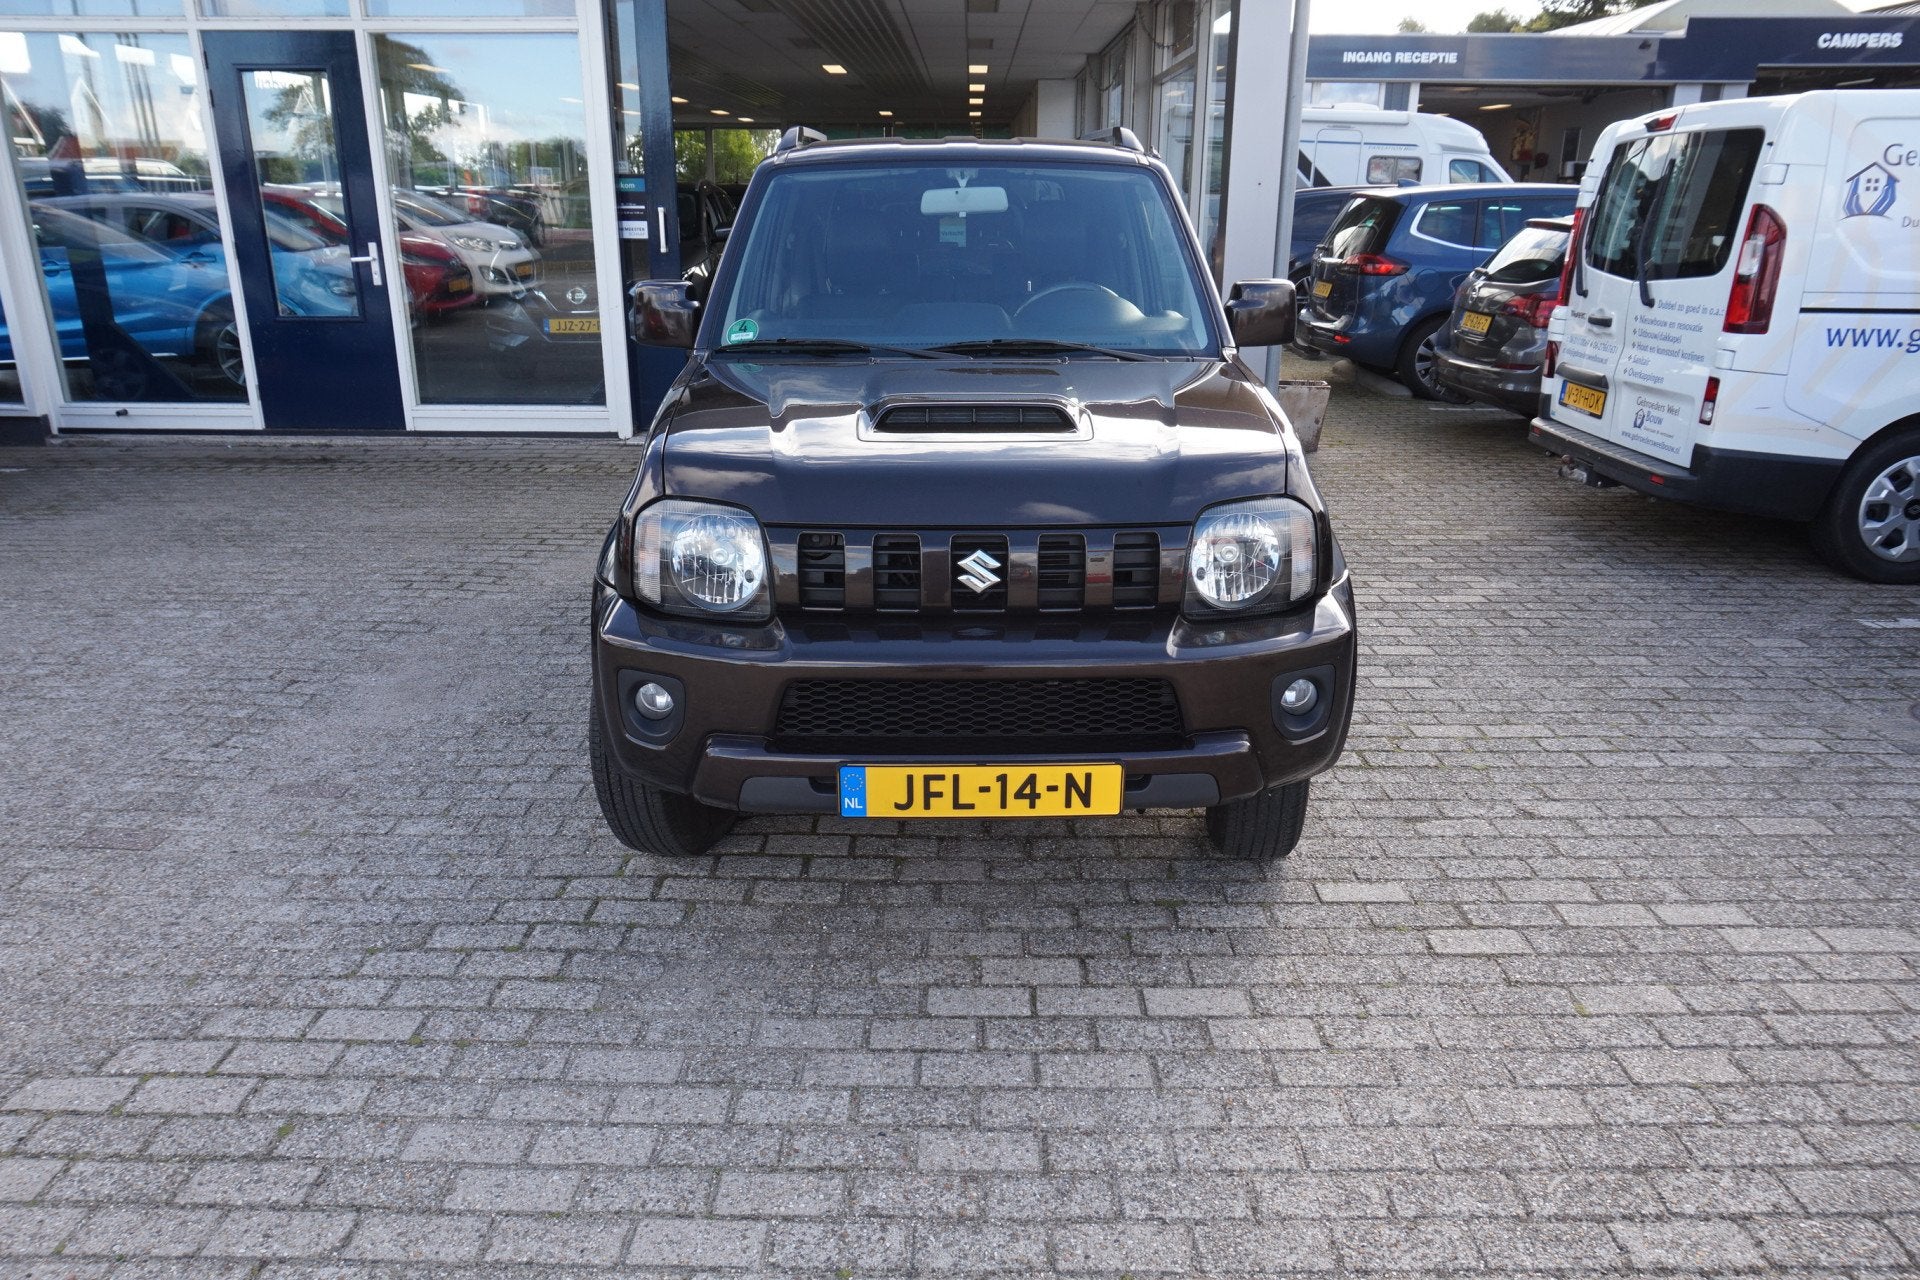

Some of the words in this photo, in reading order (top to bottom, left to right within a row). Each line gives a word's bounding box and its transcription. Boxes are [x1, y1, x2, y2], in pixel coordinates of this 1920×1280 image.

[1817, 32, 1903, 49] CAMPERS
[1343, 51, 1392, 63] INGANG
[1395, 51, 1458, 64] RECEPTIE
[1883, 143, 1920, 167] Ge
[738, 320, 748, 333] 4
[1636, 395, 1666, 412] Gebroeders
[844, 797, 863, 809] NL
[894, 772, 1092, 811] JFL-14-N
